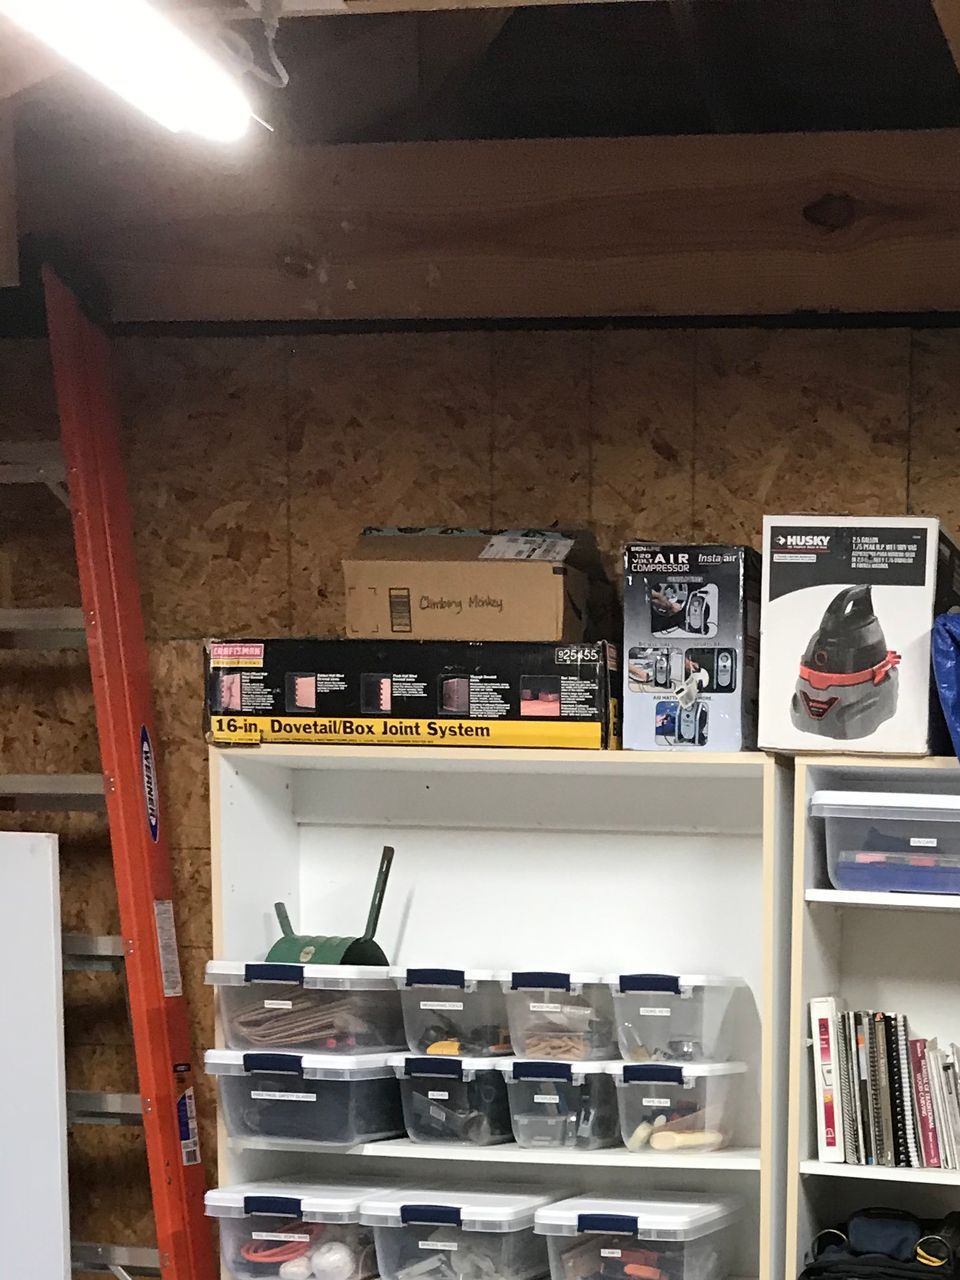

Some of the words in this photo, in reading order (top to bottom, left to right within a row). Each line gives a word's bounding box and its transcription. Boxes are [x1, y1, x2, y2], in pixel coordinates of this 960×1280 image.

[787, 536, 830, 545] HUSKY
[654, 553, 689, 564] AIR
[698, 554, 721, 563] Insta
[631, 564, 690, 572] COMPRESSOR
[419, 595, 463, 615] Climbing
[469, 595, 504, 612] Monkey
[213, 647, 261, 655] CRAFTSMAN
[216, 718, 264, 734] 16-in.
[271, 719, 374, 735] Dovetail/Box
[382, 721, 421, 736] Joint
[427, 722, 491, 738] System
[143, 750, 157, 822] WERNER
